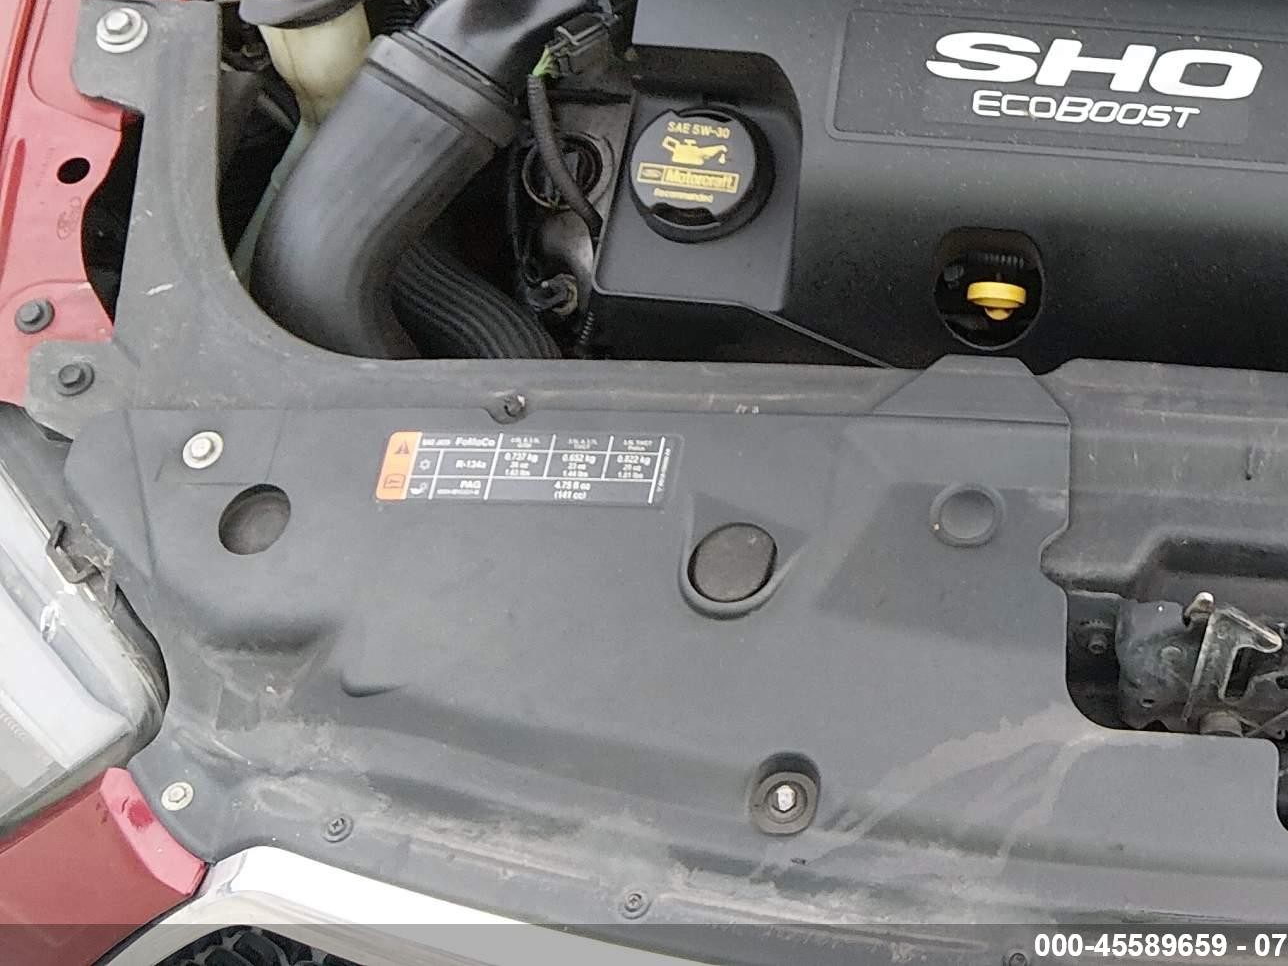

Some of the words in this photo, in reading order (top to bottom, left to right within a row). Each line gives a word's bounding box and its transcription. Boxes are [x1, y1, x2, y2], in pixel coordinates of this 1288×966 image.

[926, 32, 1263, 100] SHO
[667, 121, 690, 134] SAE
[692, 124, 731, 139] 5W-30
